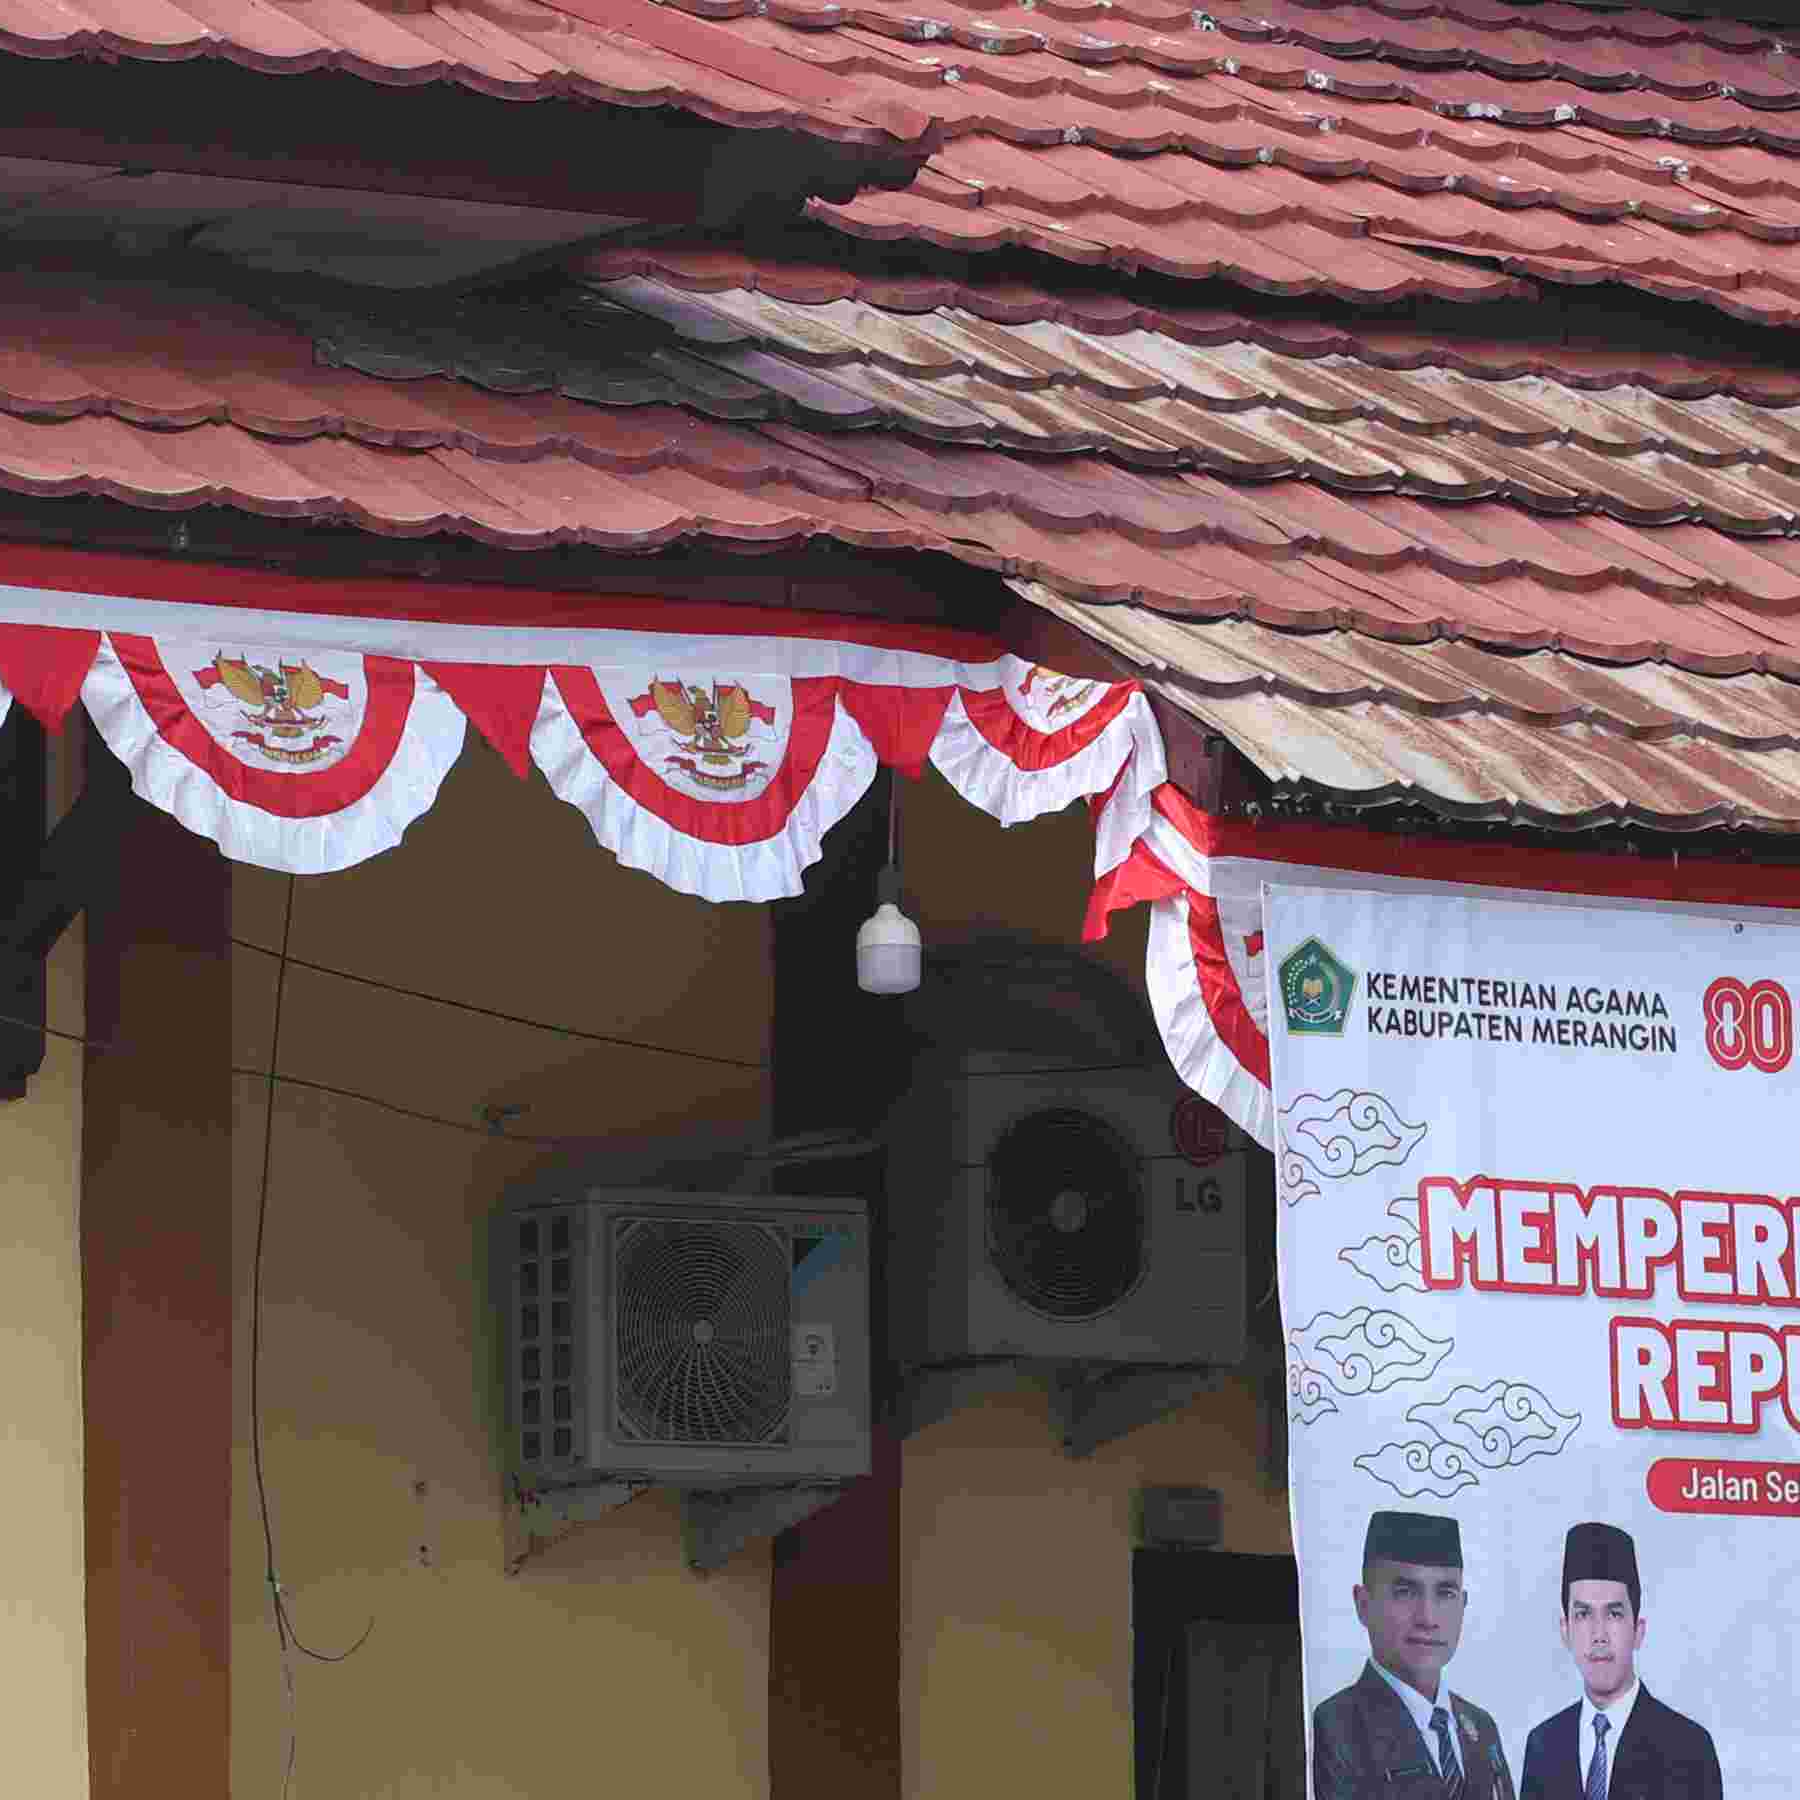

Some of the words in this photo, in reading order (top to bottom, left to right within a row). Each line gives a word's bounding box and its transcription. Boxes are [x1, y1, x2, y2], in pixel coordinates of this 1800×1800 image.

[1366, 971, 1557, 1011] KEMENTERIAN
[1565, 985, 1669, 1019] AGAMA
[1367, 1006, 1523, 1043] KABUPATEN
[1531, 1017, 1677, 1053] MERANGIN
[1703, 976, 1792, 1073] 80
[1175, 1176, 1223, 1213] LG
[1681, 1467, 1759, 1503] Jalan
